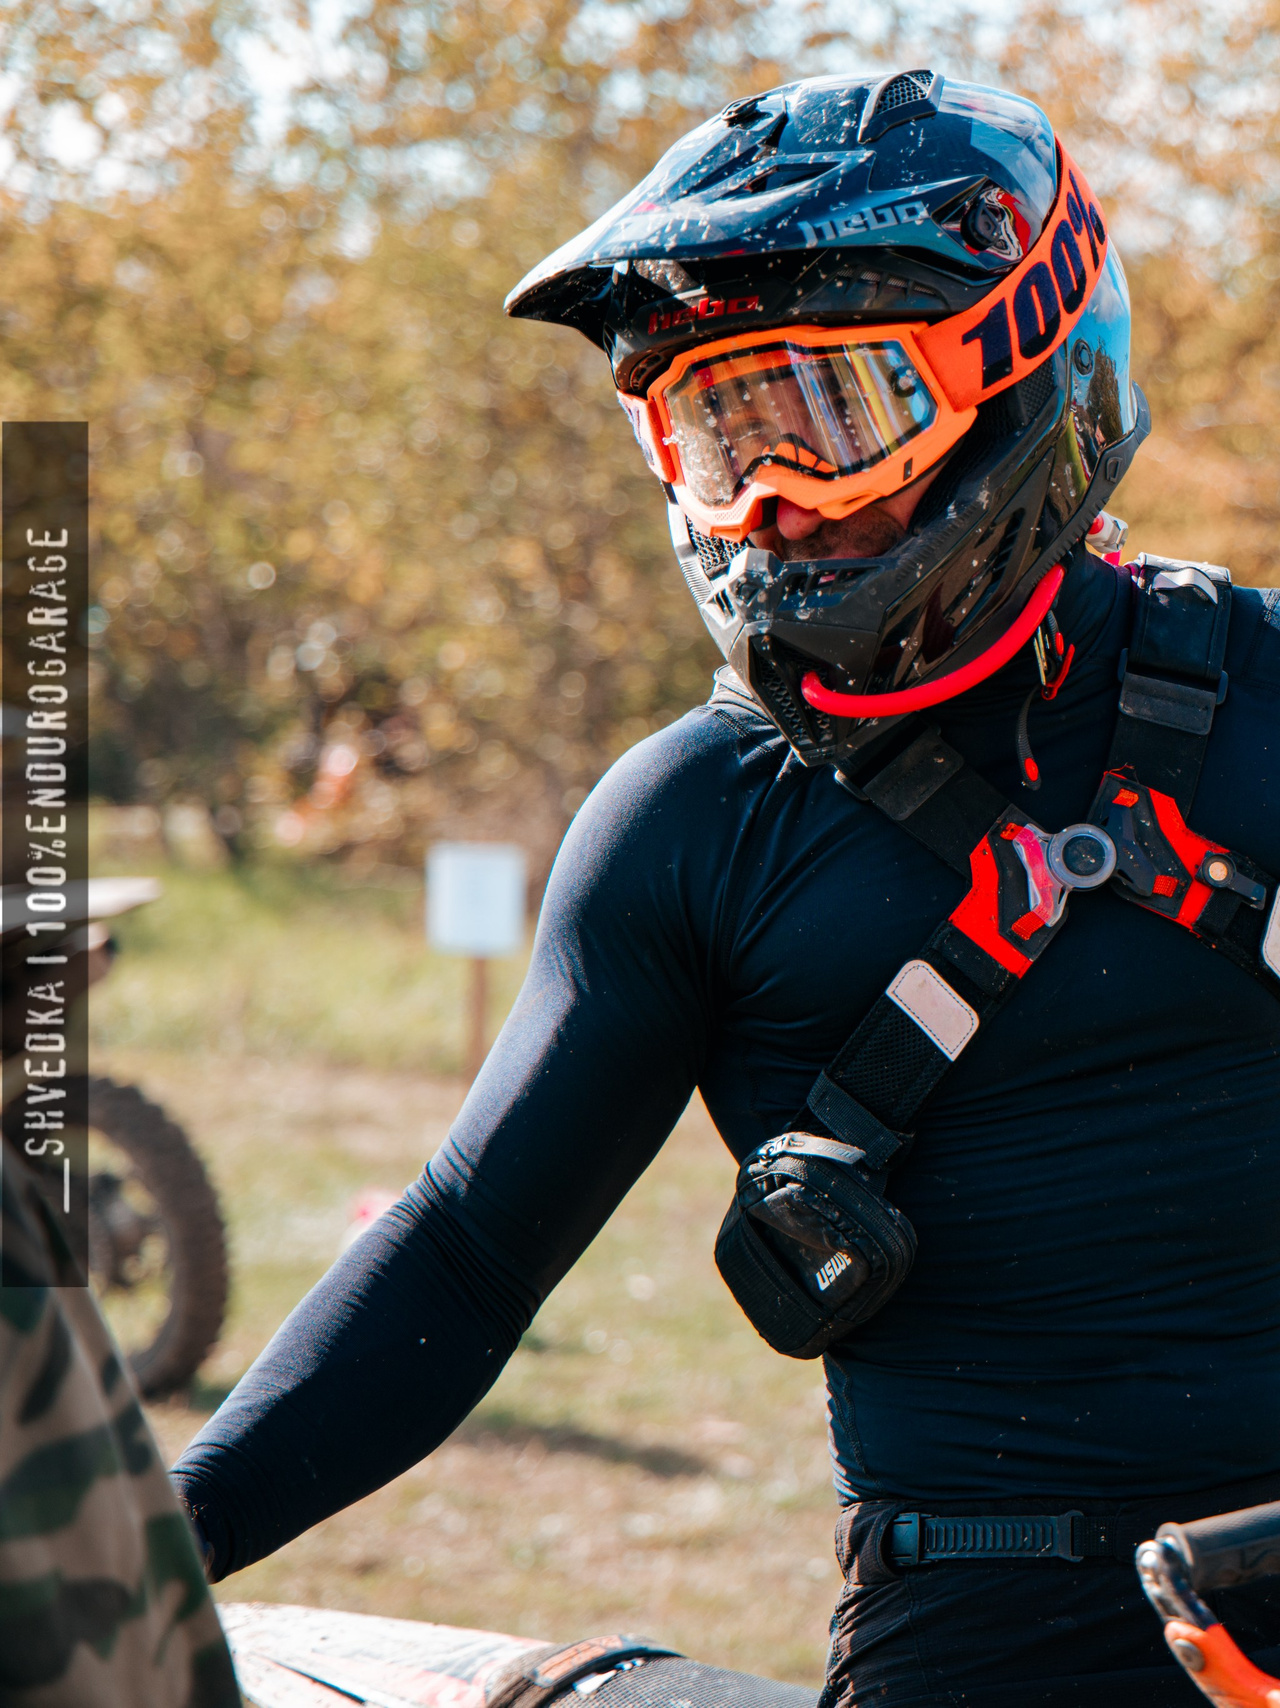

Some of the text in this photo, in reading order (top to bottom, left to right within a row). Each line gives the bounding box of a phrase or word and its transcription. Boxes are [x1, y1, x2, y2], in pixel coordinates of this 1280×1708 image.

[798, 200, 931, 248] hebo
[961, 168, 1106, 390] 100%
[815, 1251, 852, 1291] USWE
